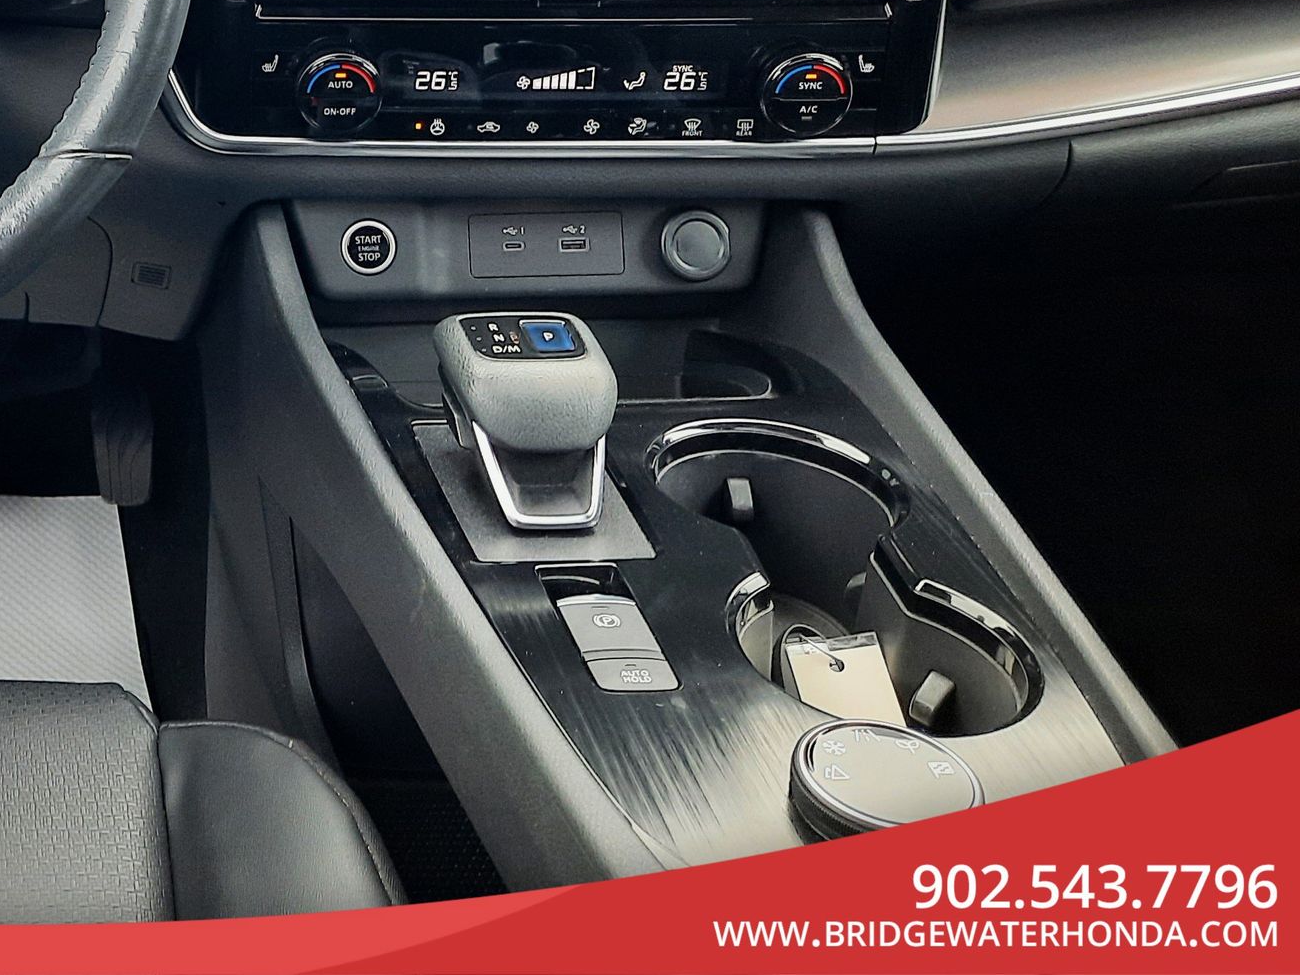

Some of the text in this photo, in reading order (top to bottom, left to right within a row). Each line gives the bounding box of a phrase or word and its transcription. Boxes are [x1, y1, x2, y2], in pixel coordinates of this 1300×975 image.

[328, 80, 353, 89] AUTO
[798, 82, 823, 91] SYNC
[799, 105, 818, 114] A/C
[520, 226, 525, 235] 1
[579, 225, 586, 234] 2
[355, 234, 381, 245] START
[358, 251, 381, 262] STOP
[488, 323, 499, 332] R
[493, 333, 505, 342] N
[544, 332, 553, 342] P
[492, 345, 521, 353] D/M
